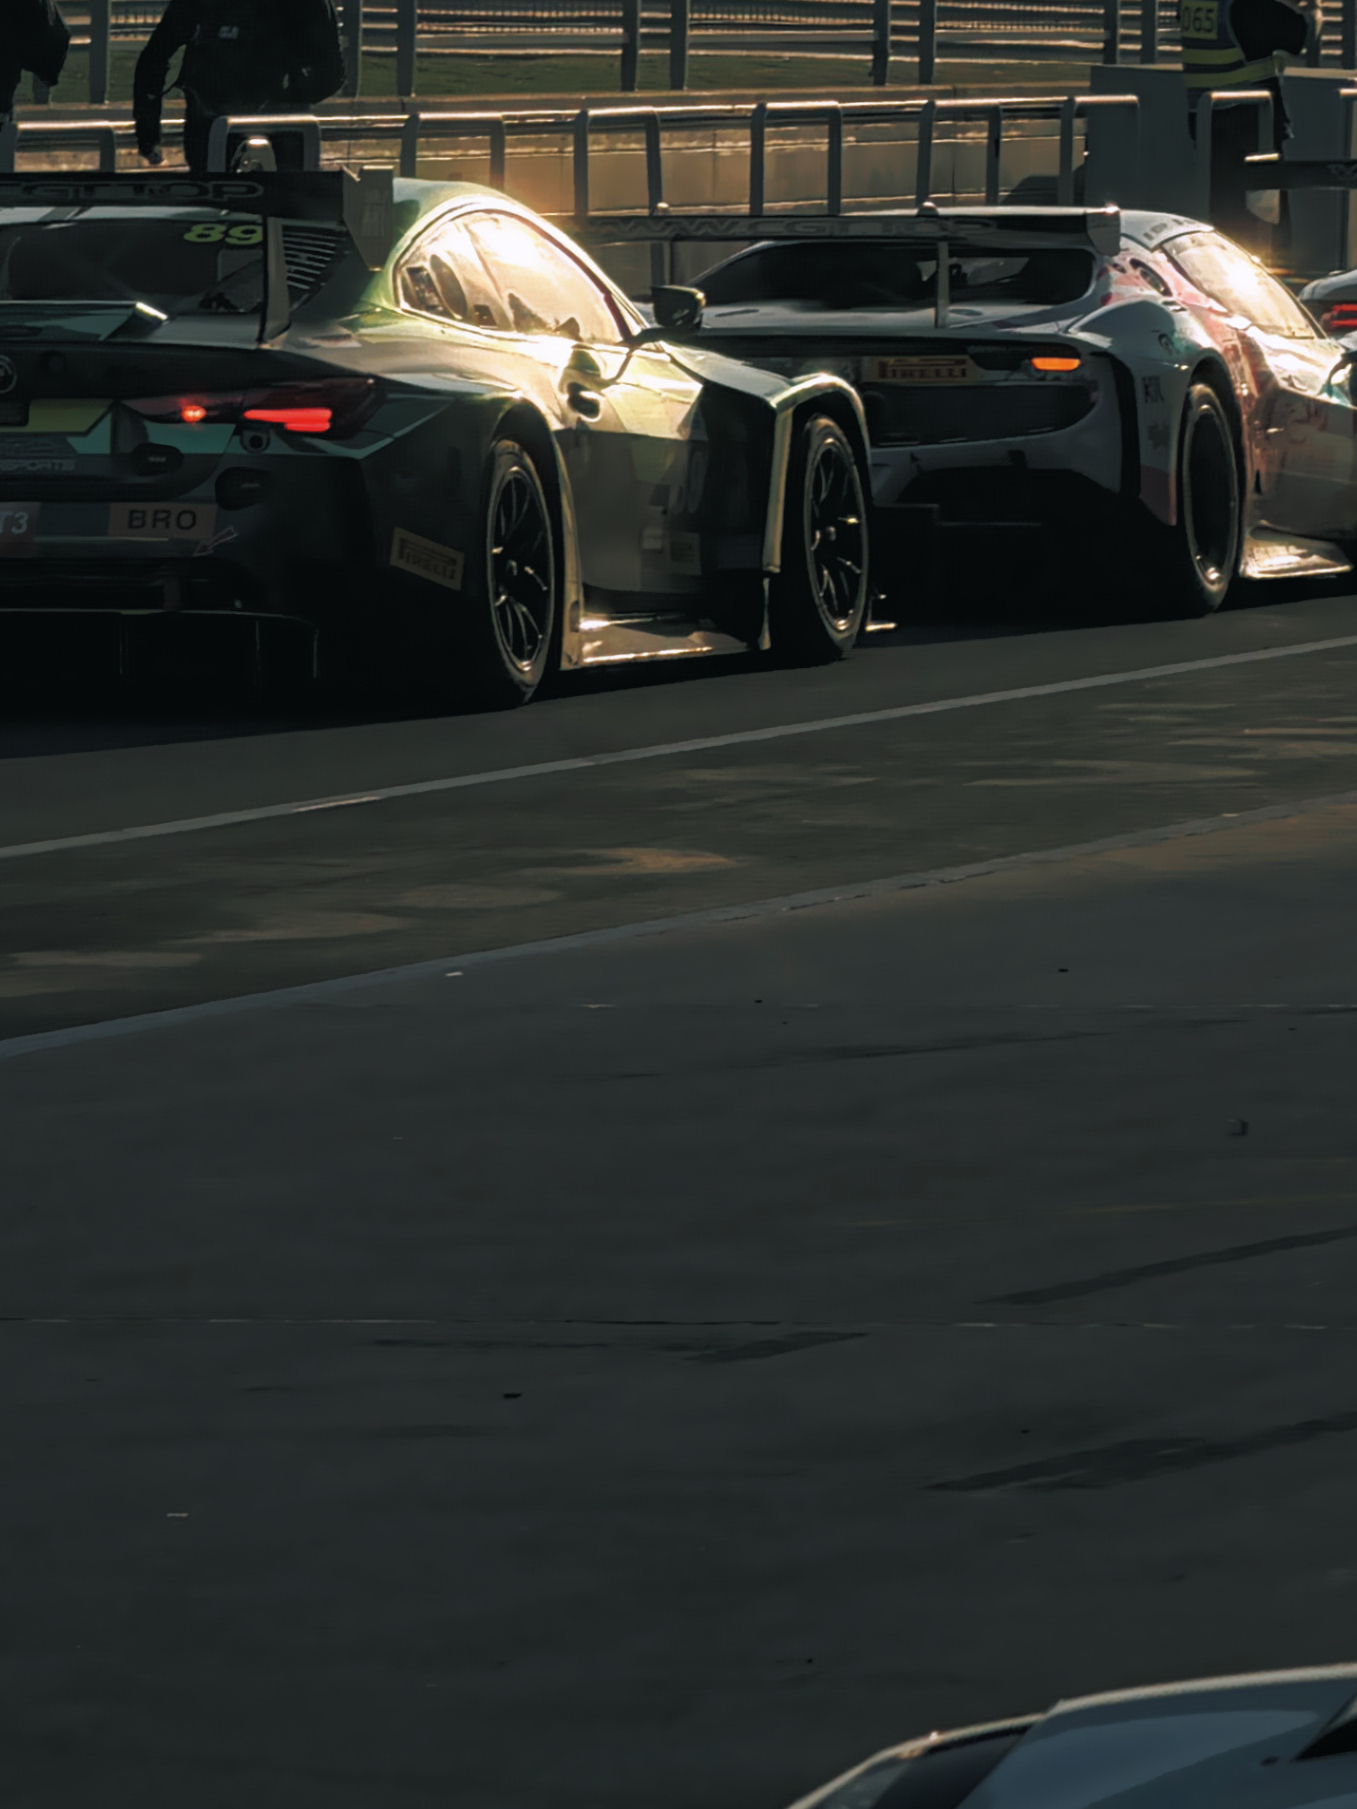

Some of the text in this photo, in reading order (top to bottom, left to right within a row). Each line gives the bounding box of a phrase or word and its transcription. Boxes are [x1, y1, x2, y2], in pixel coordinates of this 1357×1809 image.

[1182, 5, 1215, 33] 065
[183, 223, 263, 246] 89
[128, 509, 197, 531] BRO
